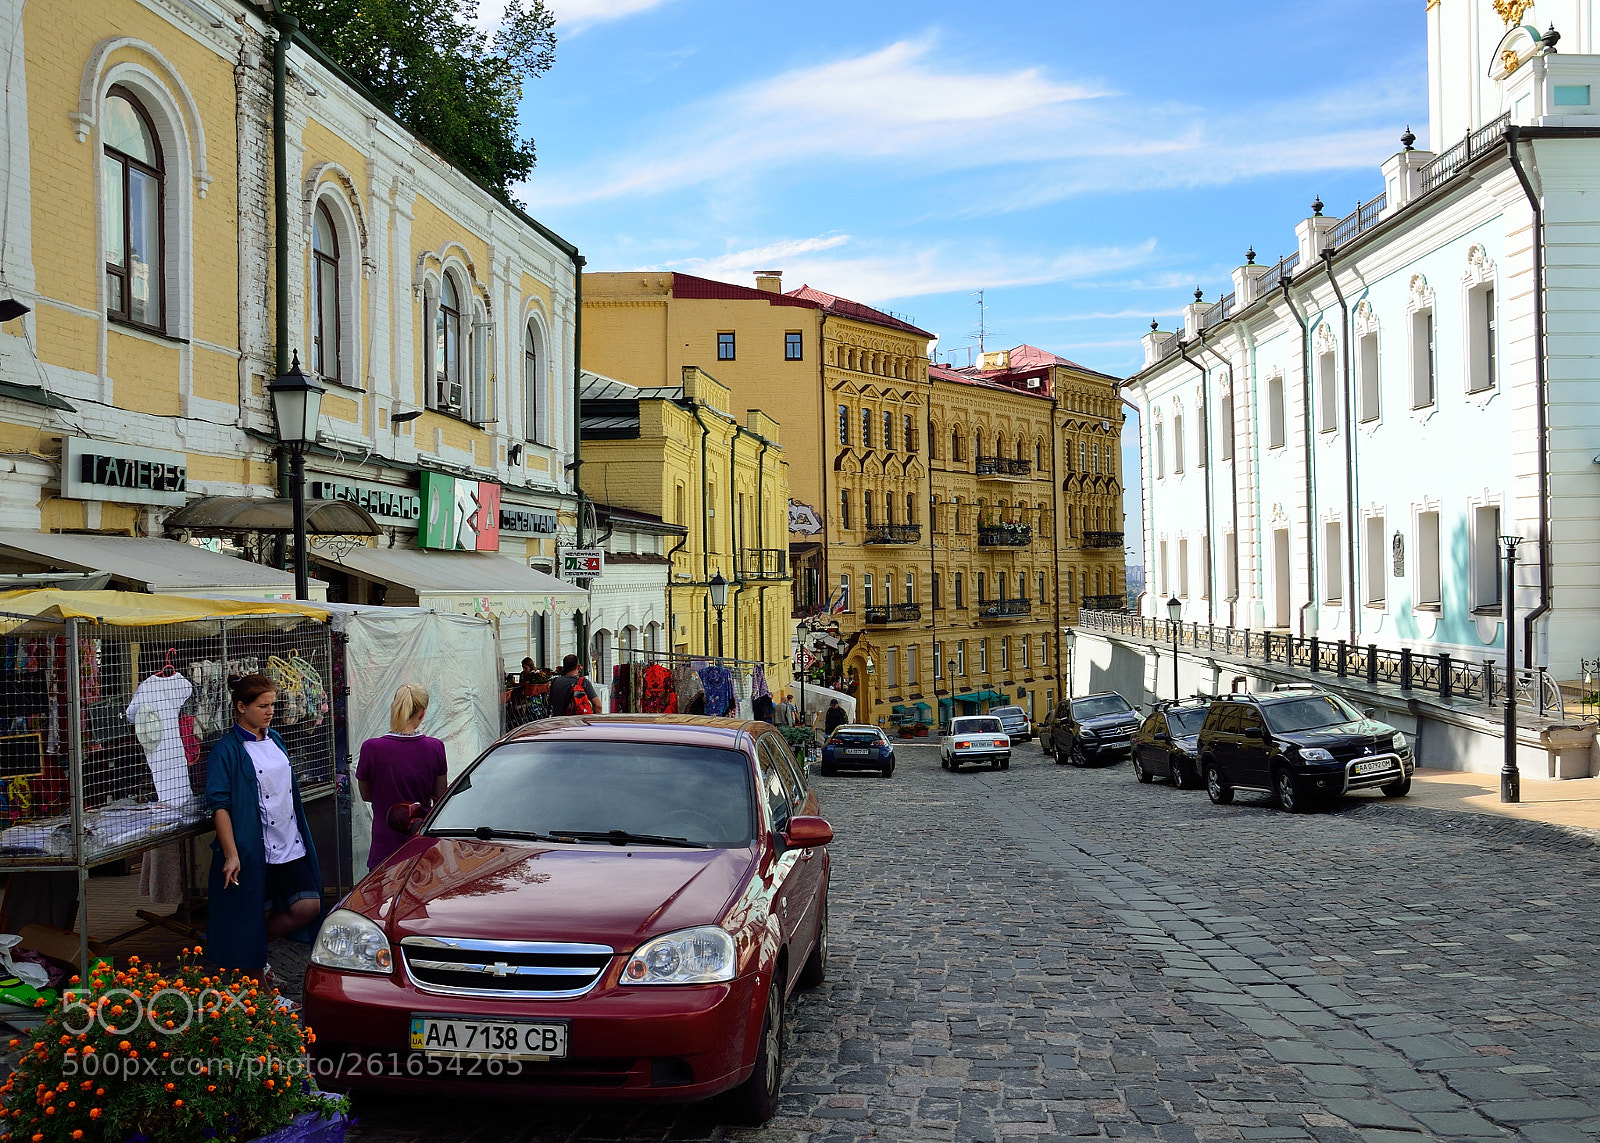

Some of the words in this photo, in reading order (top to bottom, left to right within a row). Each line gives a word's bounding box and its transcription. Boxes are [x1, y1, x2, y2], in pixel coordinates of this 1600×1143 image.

[92, 454, 187, 491] ГАЛЕРЕЯ
[425, 1023, 458, 1047] AA
[464, 1025, 518, 1050] 7138
[525, 1028, 558, 1051] CB
